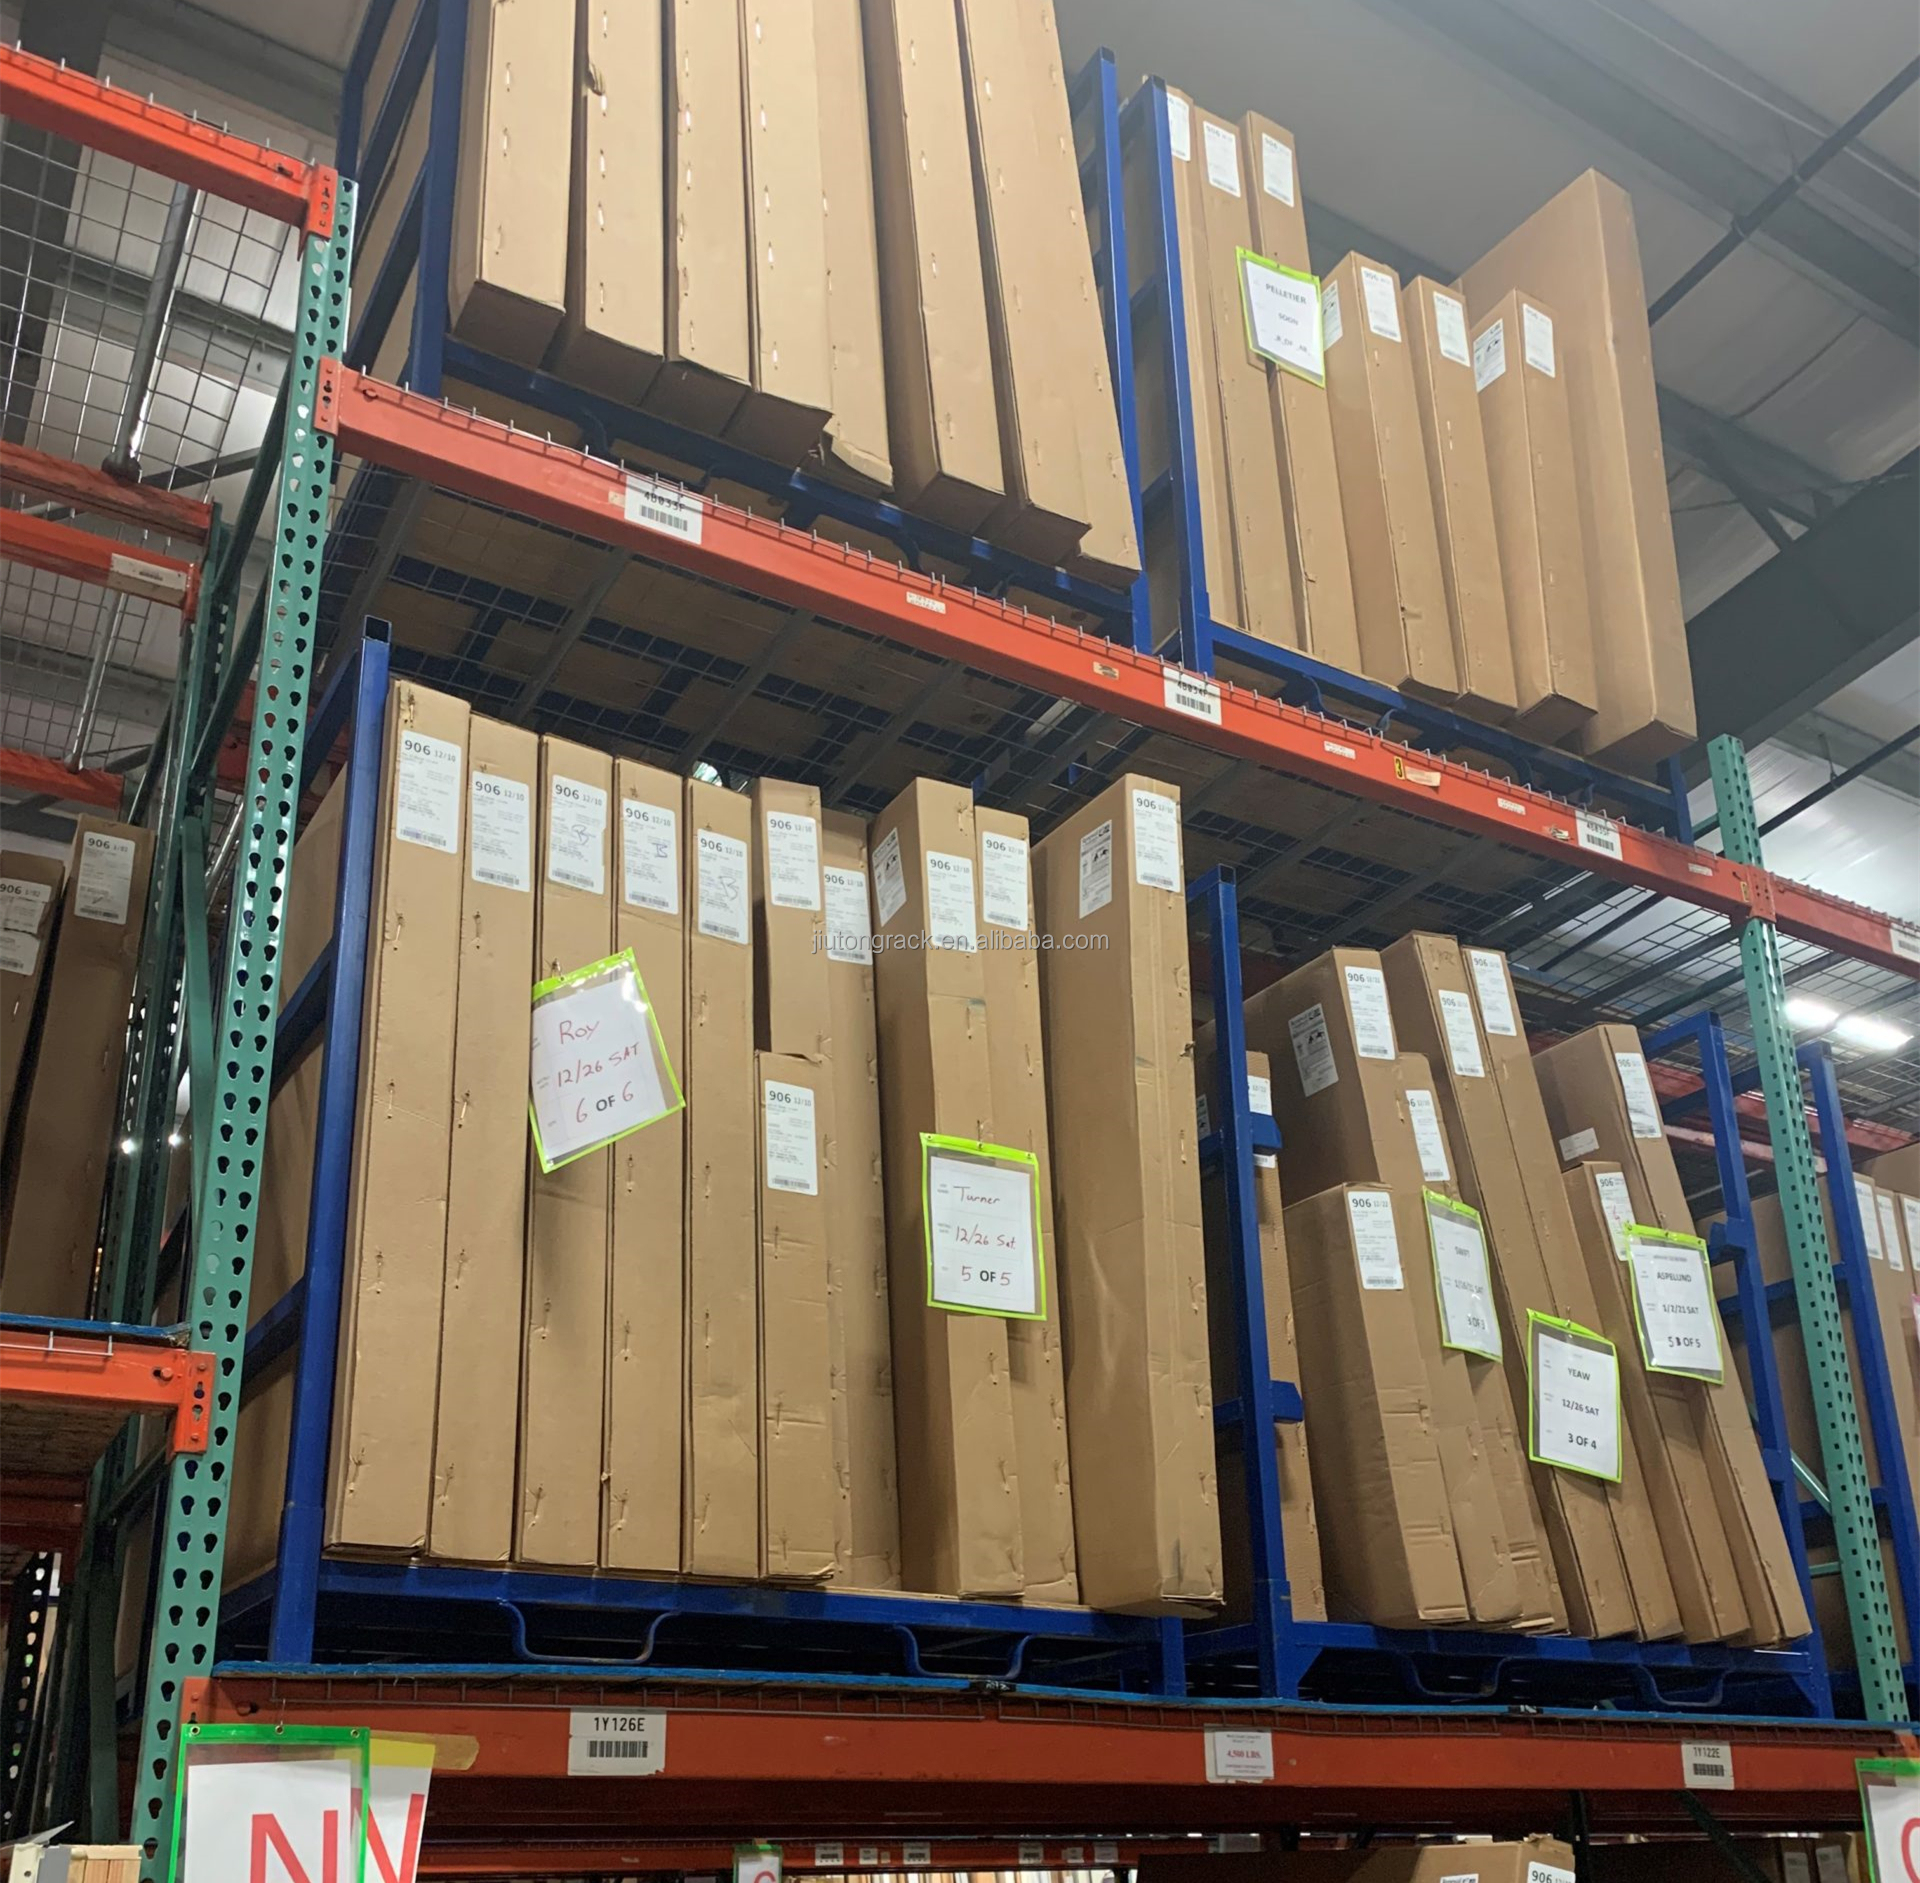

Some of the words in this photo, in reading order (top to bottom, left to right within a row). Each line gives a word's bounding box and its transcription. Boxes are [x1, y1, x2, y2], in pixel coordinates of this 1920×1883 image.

[1265, 283, 1306, 304] PELLETIER
[404, 739, 431, 756] 906
[434, 750, 457, 763] 12/10
[474, 780, 501, 796] 906
[503, 788, 525, 802] 12/10
[555, 784, 580, 800] 906
[582, 793, 603, 806] 12/10
[1136, 797, 1157, 810] 906
[625, 807, 650, 823] 906
[651, 814, 672, 827] 12/10
[769, 818, 792, 831] 906
[88, 837, 110, 850] 906
[700, 838, 723, 853] 906
[725, 846, 744, 858] 12/10
[985, 839, 1006, 852] 906
[929, 859, 951, 871] 906
[824, 873, 845, 886] 906
[0, 883, 22, 895] 906
[1347, 972, 1365, 983] 906
[559, 1020, 600, 1045] Roy
[558, 1059, 603, 1088] 12/26
[608, 1042, 640, 1067] SAT
[575, 1098, 588, 1123] 6
[596, 1095, 617, 1112] OF
[621, 1081, 634, 1102] 6
[769, 1090, 792, 1104] 906
[953, 1185, 1001, 1206] Turner
[1352, 1198, 1372, 1208] 906
[955, 1223, 990, 1246] 12/26
[961, 1266, 973, 1282] 5
[979, 1270, 997, 1283] OF
[1000, 1272, 1012, 1287] 5
[1688, 1305, 1699, 1314] SAT
[1683, 1336, 1694, 1347] OF
[1567, 1367, 1591, 1381] YEAW
[1561, 1398, 1584, 1413] 12/26
[1584, 1405, 1600, 1416] SAT
[1567, 1432, 1574, 1443] 3
[1575, 1435, 1589, 1447] OF
[1590, 1440, 1597, 1450] 4
[594, 1717, 646, 1732] 1Y126E
[1693, 1746, 1721, 1759] 1Y122E
